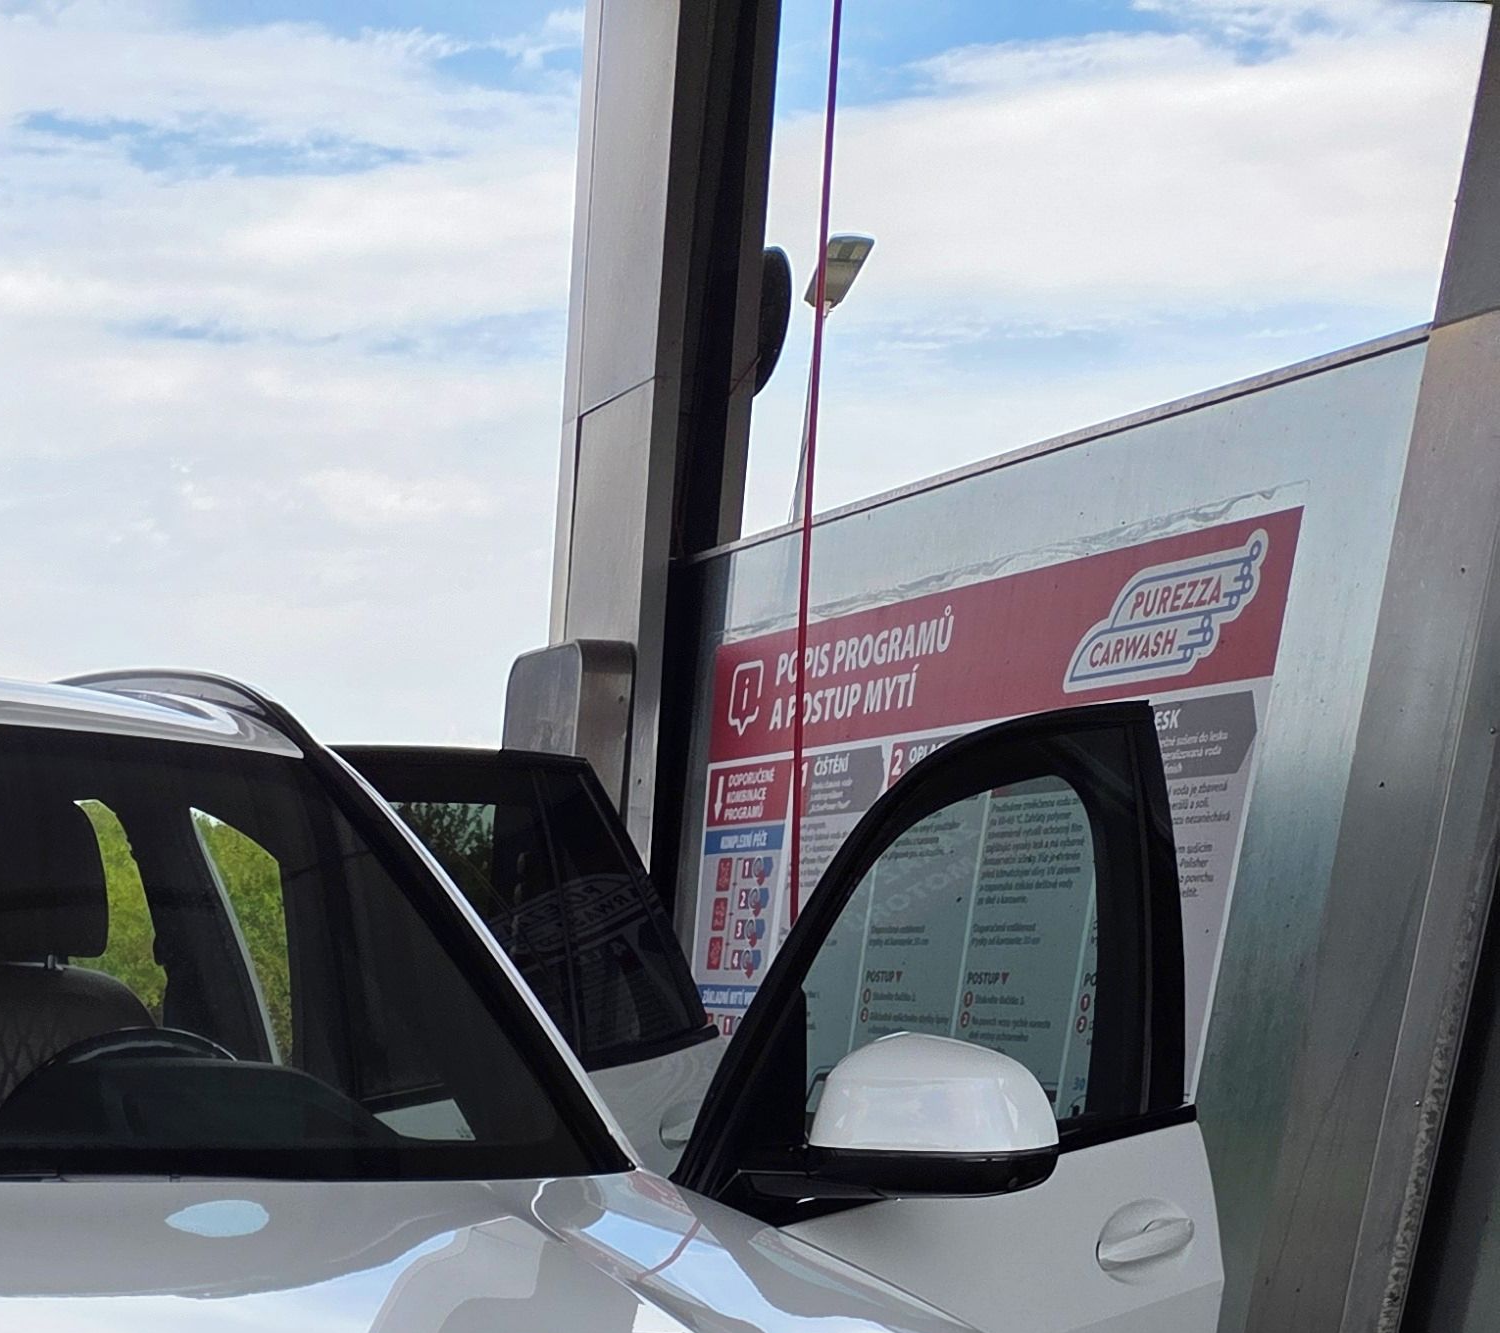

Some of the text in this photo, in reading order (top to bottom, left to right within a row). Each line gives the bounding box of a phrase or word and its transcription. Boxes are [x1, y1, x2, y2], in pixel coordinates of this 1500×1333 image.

[1129, 574, 1222, 620] PUREZZA
[832, 605, 955, 675] PROGRAMŮ
[1089, 628, 1178, 668] CARWASH
[769, 698, 782, 731] A
[863, 663, 919, 715] MYTÍ
[801, 762, 809, 788] 1
[814, 752, 850, 777] ČIŠTĚNÍ
[891, 749, 903, 777] 2
[967, 971, 1000, 985] POSTUP
